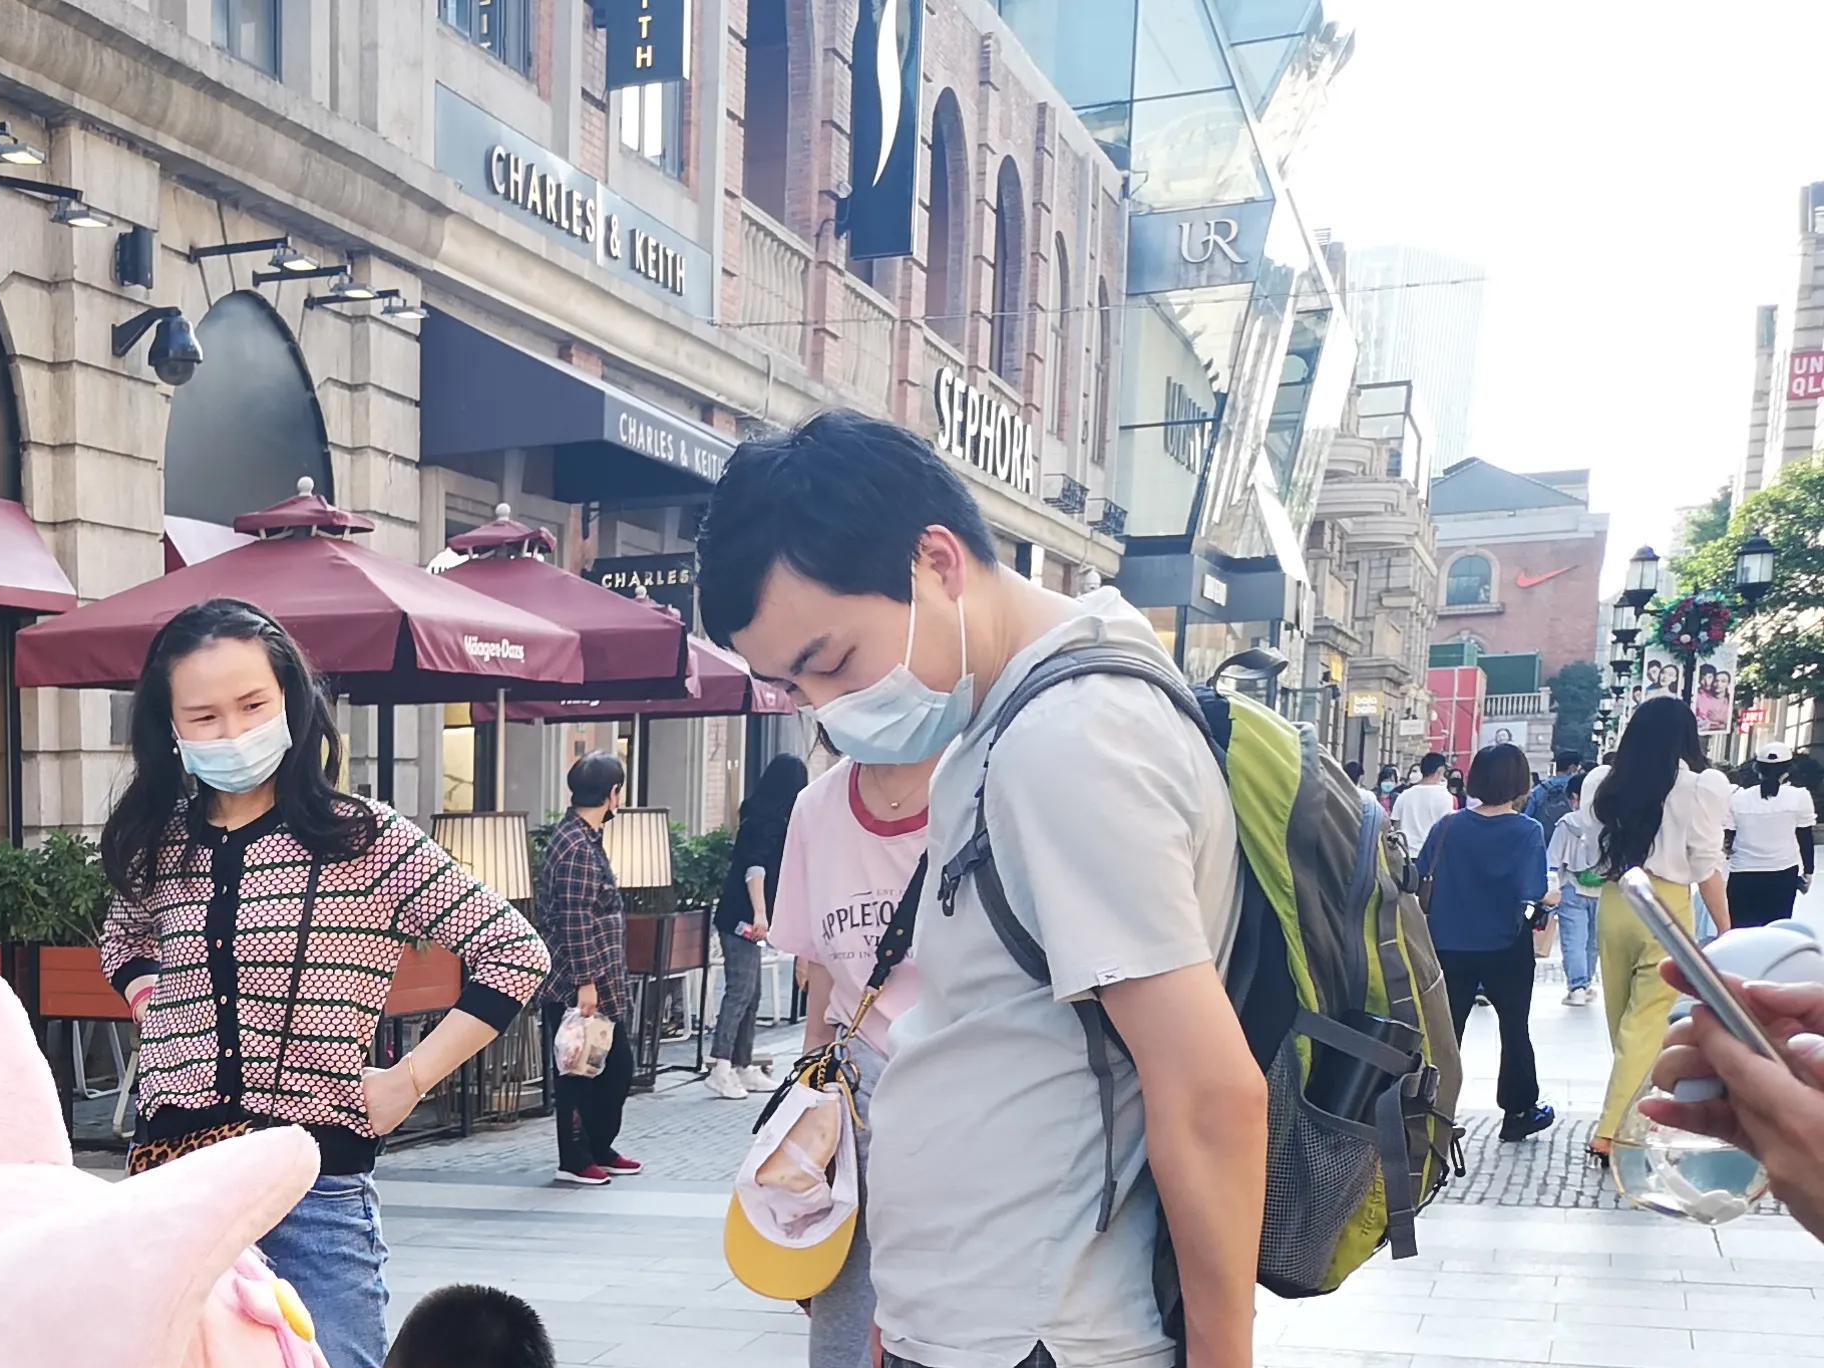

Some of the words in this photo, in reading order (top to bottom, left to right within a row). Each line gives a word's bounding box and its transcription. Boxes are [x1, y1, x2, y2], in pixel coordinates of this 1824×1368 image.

[488, 145, 597, 243] CHARLES
[609, 213, 622, 259] &
[633, 228, 686, 296] KEITH
[1179, 218, 1249, 265] UR
[1791, 376, 1824, 397] QL
[619, 412, 674, 462] CHARLES
[680, 440, 689, 468] &
[937, 366, 1033, 496] SEPHORA
[601, 570, 690, 588] CHARLES
[821, 900, 896, 942] APPLETO
